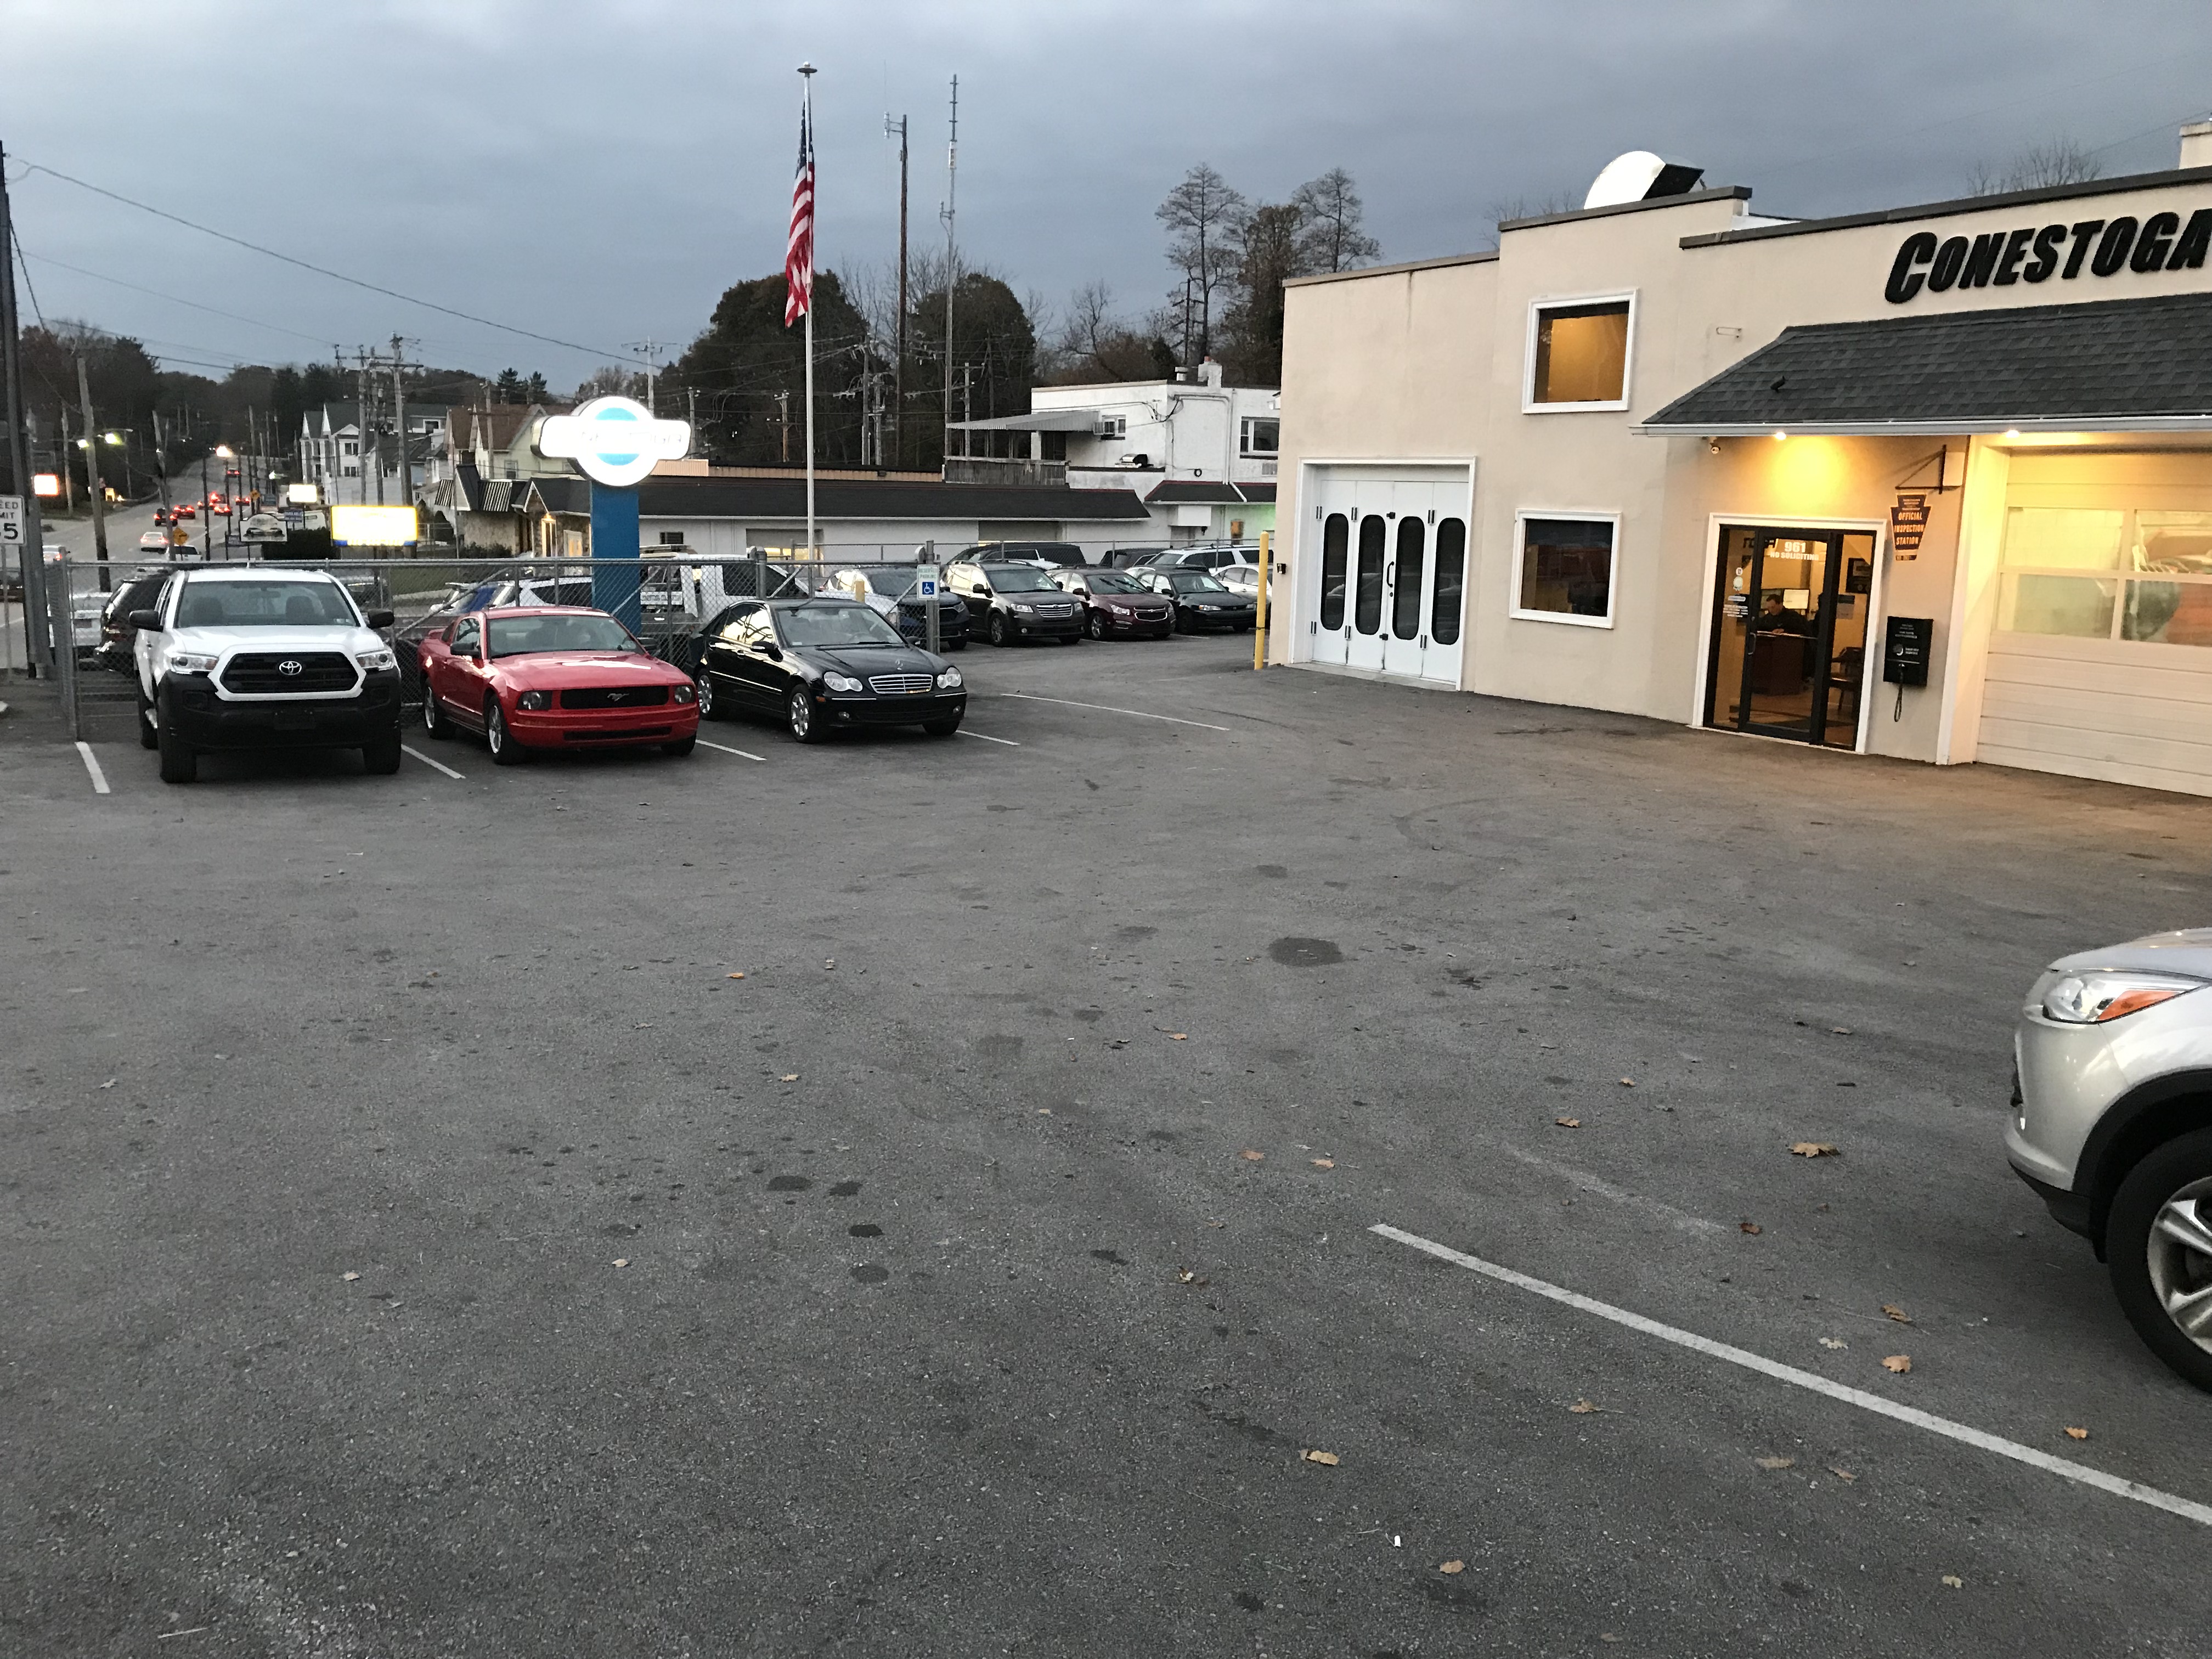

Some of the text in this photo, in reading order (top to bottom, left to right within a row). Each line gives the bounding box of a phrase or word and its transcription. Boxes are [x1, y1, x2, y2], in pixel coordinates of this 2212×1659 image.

[1884, 208, 2212, 304] CONESTOGA
[1898, 512, 1923, 521] OFFICIAL
[0, 522, 18, 540] 5
[1894, 524, 1925, 533] INSPECTION
[1896, 537, 1919, 545] STATION
[1784, 541, 1806, 553] 961
[1781, 552, 1819, 561] SOLICITING
